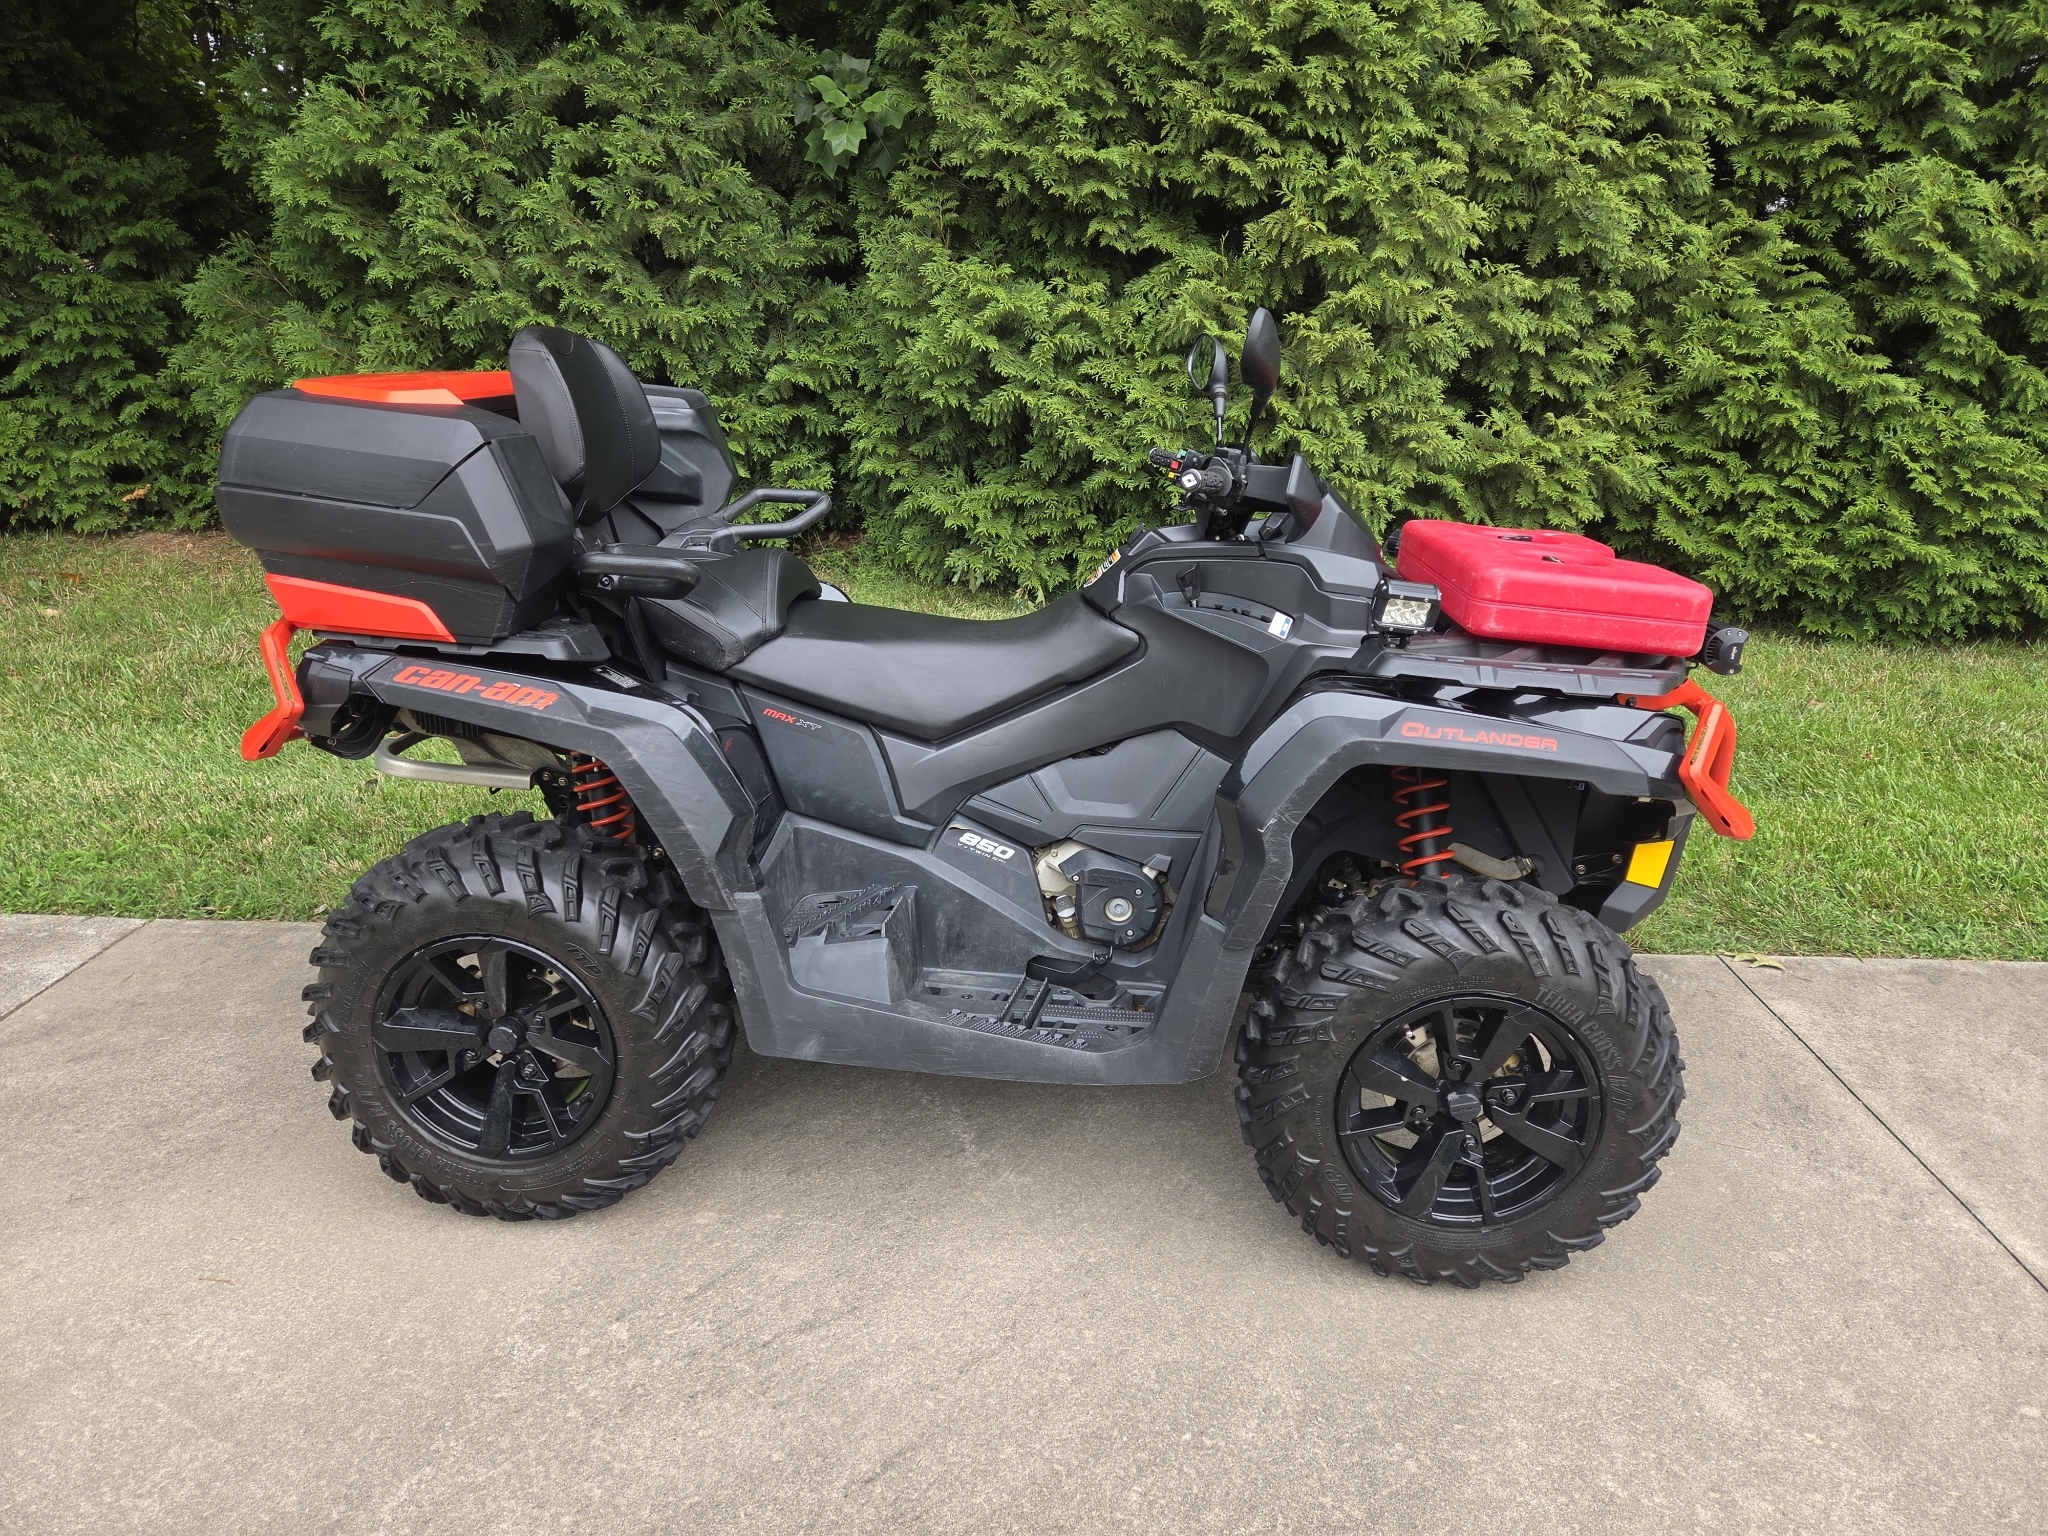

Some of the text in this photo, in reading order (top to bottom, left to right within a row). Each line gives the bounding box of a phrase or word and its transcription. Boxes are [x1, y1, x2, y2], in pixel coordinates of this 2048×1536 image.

[392, 665, 560, 710] can-am
[762, 707, 823, 731] MAX XT
[1401, 722, 1558, 752] OUTLANDER
[958, 832, 1016, 860] 850
[1092, 873, 1124, 886] ROTAX
[1533, 982, 1587, 1025] TERRA
[1580, 1019, 1623, 1071] CROSS
[382, 1119, 432, 1165] CROSS
[433, 1155, 484, 1188] TERRA
[1323, 1169, 1354, 1202] ITP
